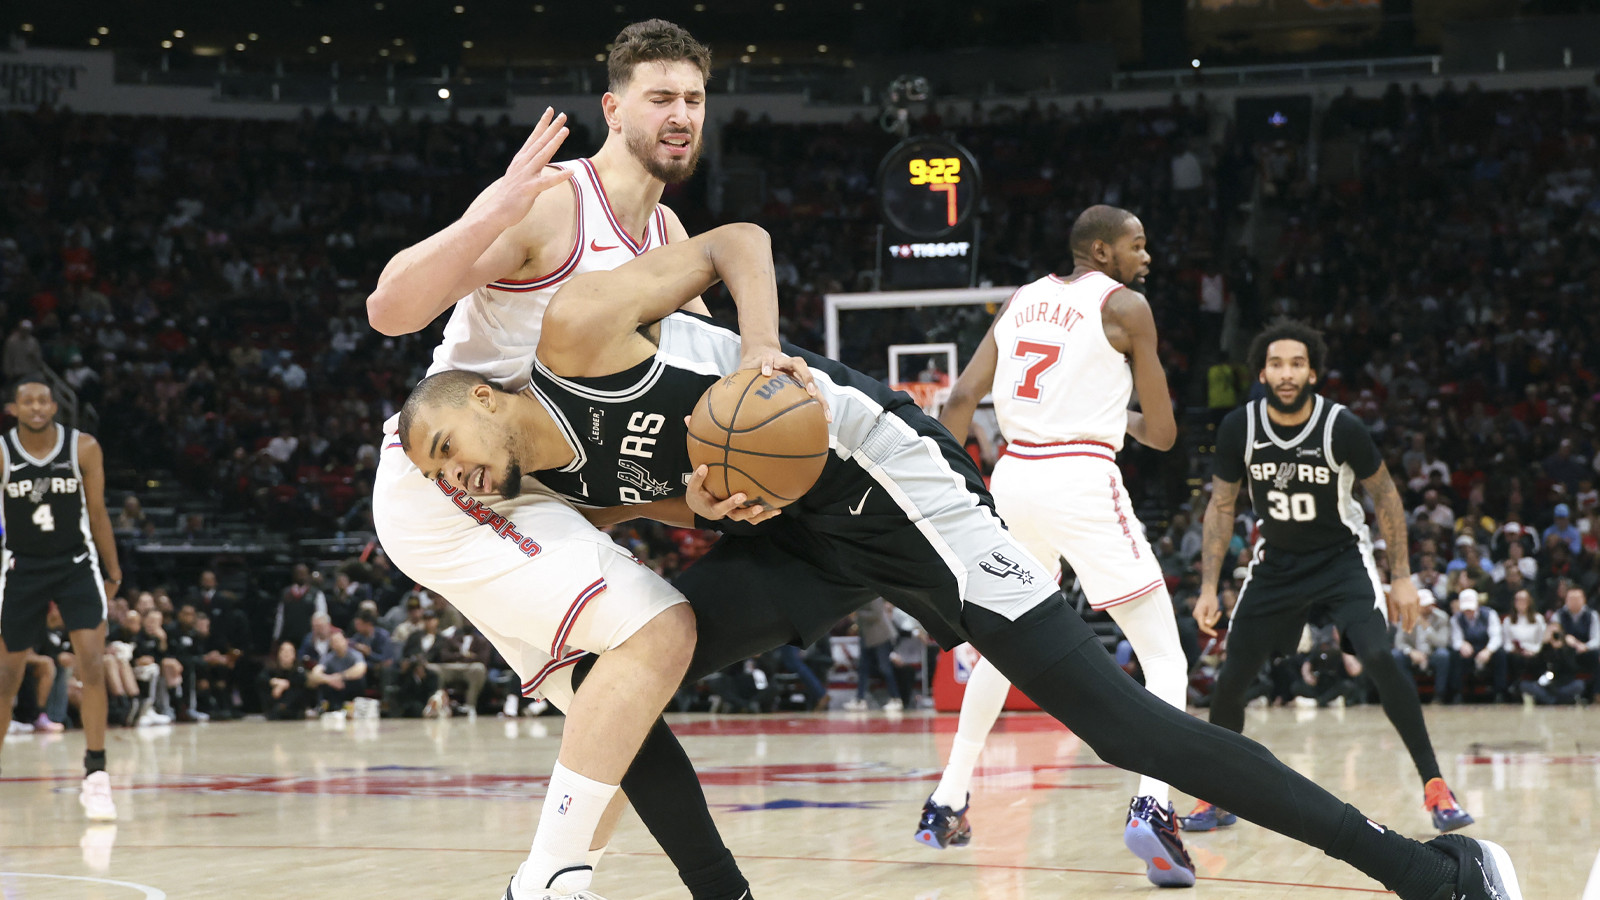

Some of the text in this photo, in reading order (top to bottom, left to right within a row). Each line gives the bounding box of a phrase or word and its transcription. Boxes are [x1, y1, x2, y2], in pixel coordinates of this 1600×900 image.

[909, 157, 961, 185] 9:22
[929, 183, 957, 226] 7
[1015, 302, 1084, 332] DURANT
[1010, 337, 1065, 404] 7
[591, 412, 601, 441] LEDGER
[617, 411, 667, 506] PURS
[32, 503, 55, 531] 4
[436, 478, 543, 558] OCKETS
[1267, 490, 1317, 521] 30
